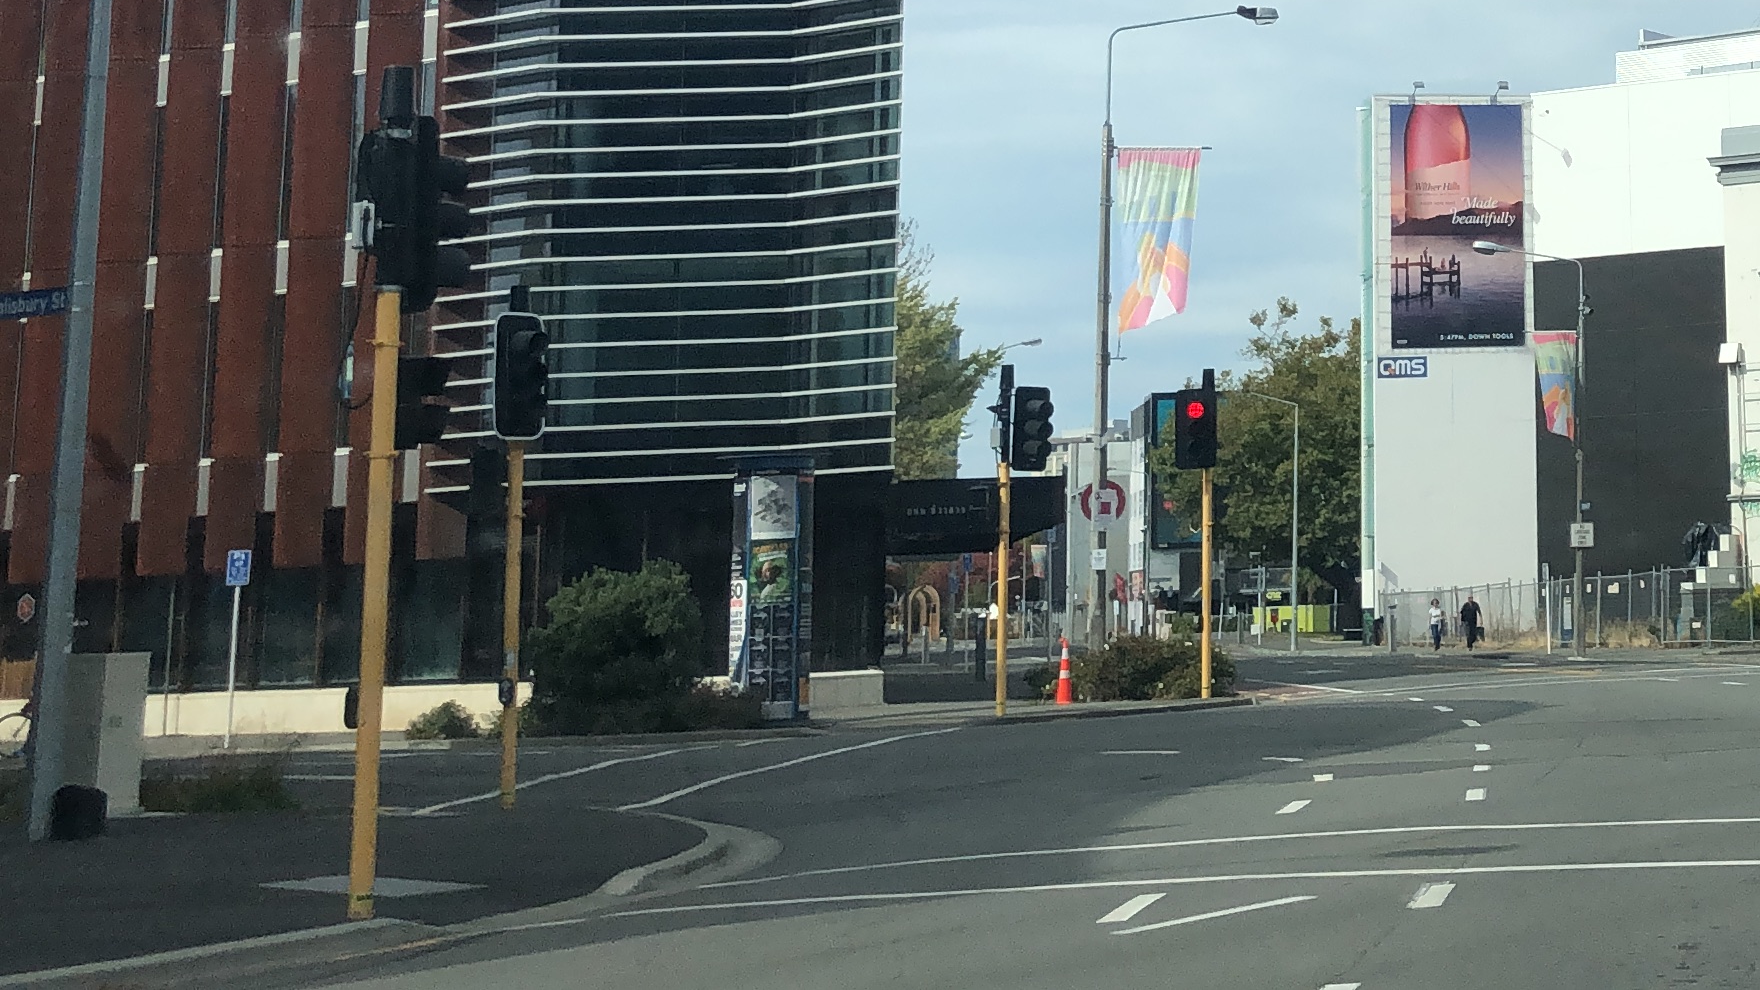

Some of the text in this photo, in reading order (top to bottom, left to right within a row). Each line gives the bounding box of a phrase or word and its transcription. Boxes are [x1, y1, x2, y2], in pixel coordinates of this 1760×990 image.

[1461, 197, 1498, 209] Made
[1450, 208, 1516, 227] beautifully
[51, 291, 66, 309] St
[1380, 358, 1425, 376] QMS
